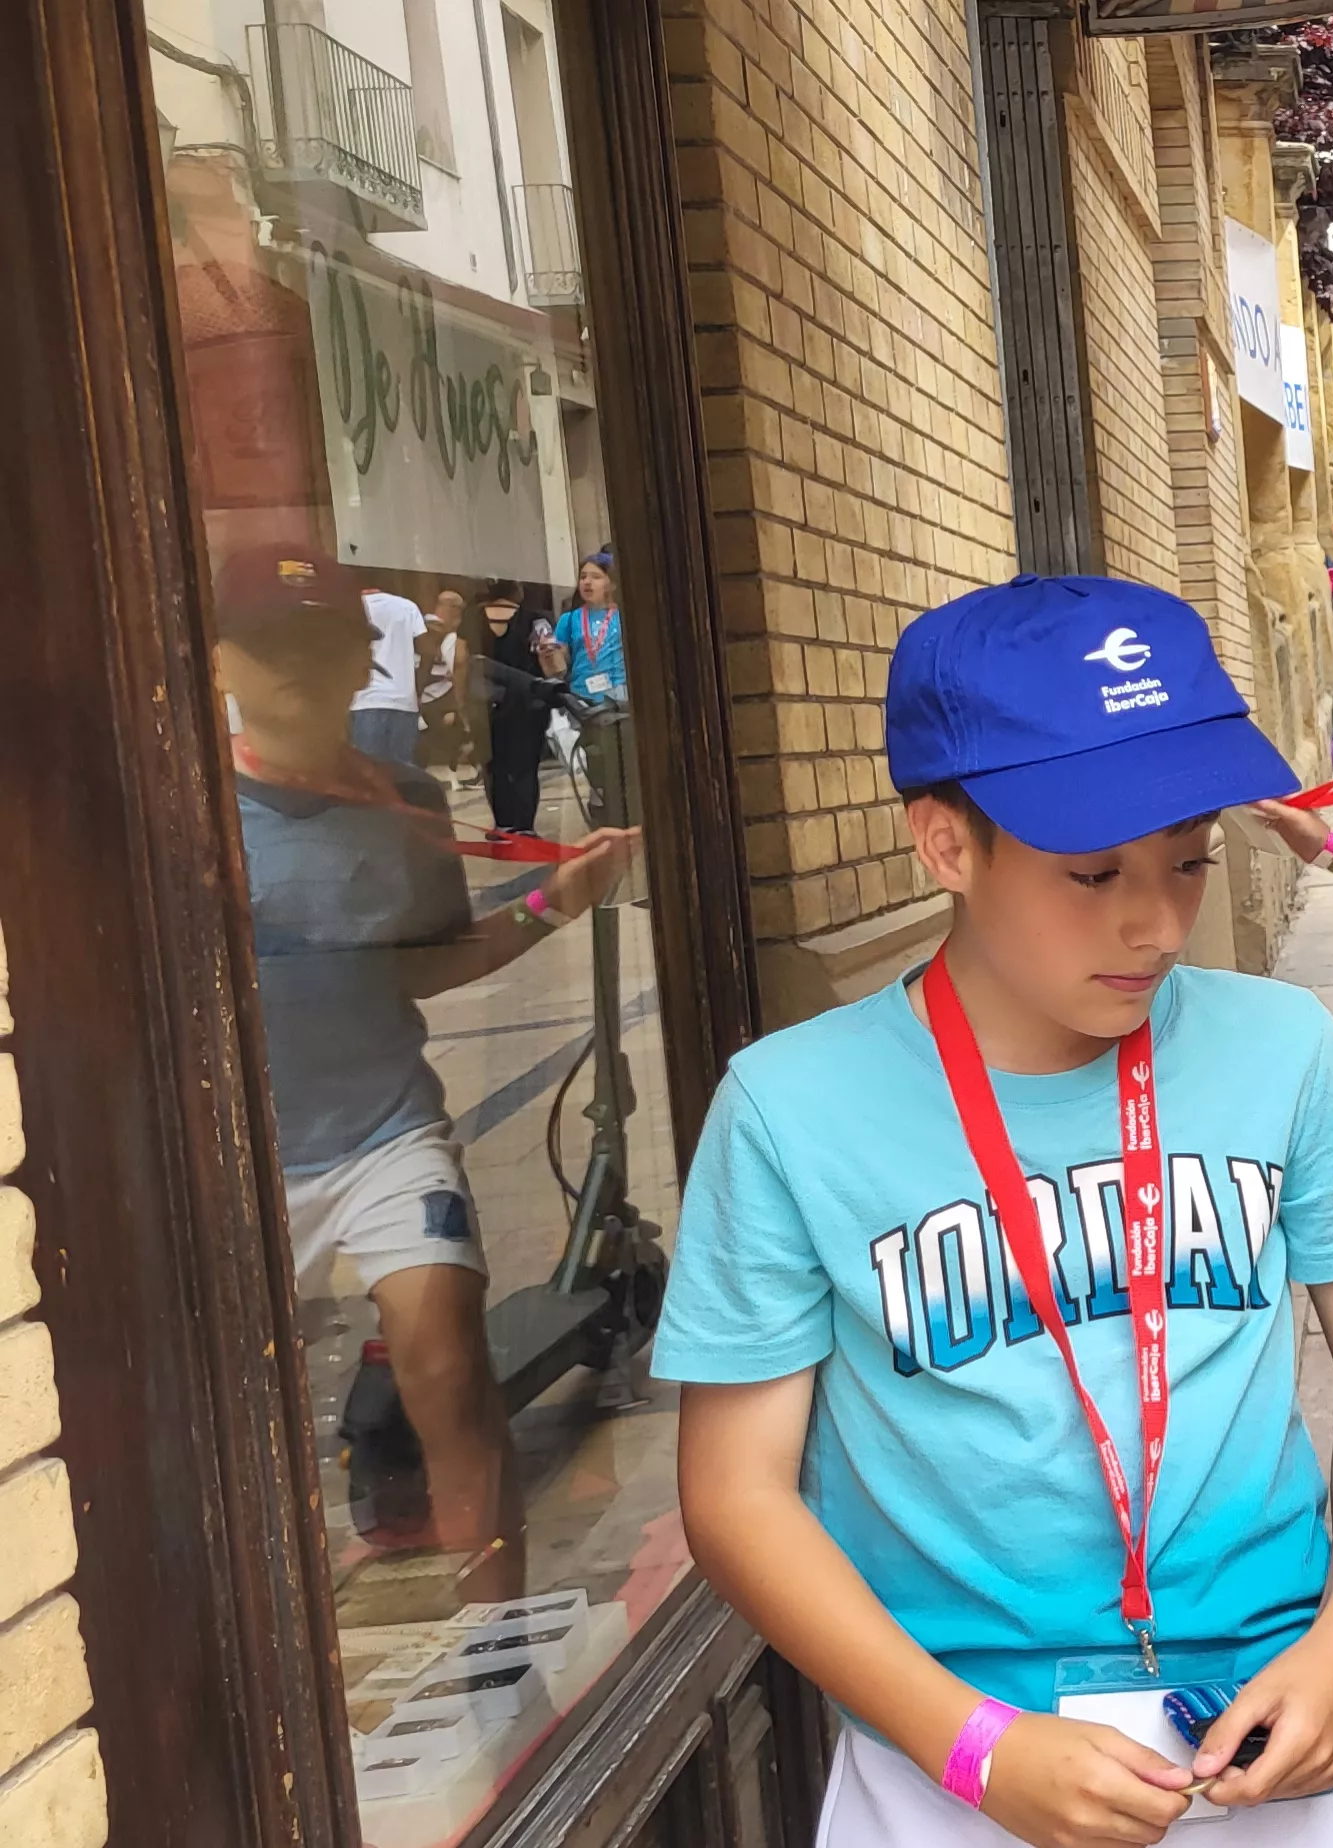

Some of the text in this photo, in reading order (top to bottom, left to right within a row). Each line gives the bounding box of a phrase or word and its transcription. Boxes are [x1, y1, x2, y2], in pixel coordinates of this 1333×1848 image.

[1101, 678, 1162, 697] Fundación
[1127, 1098, 1137, 1151] Fundación
[1131, 1220, 1142, 1277] Fundación
